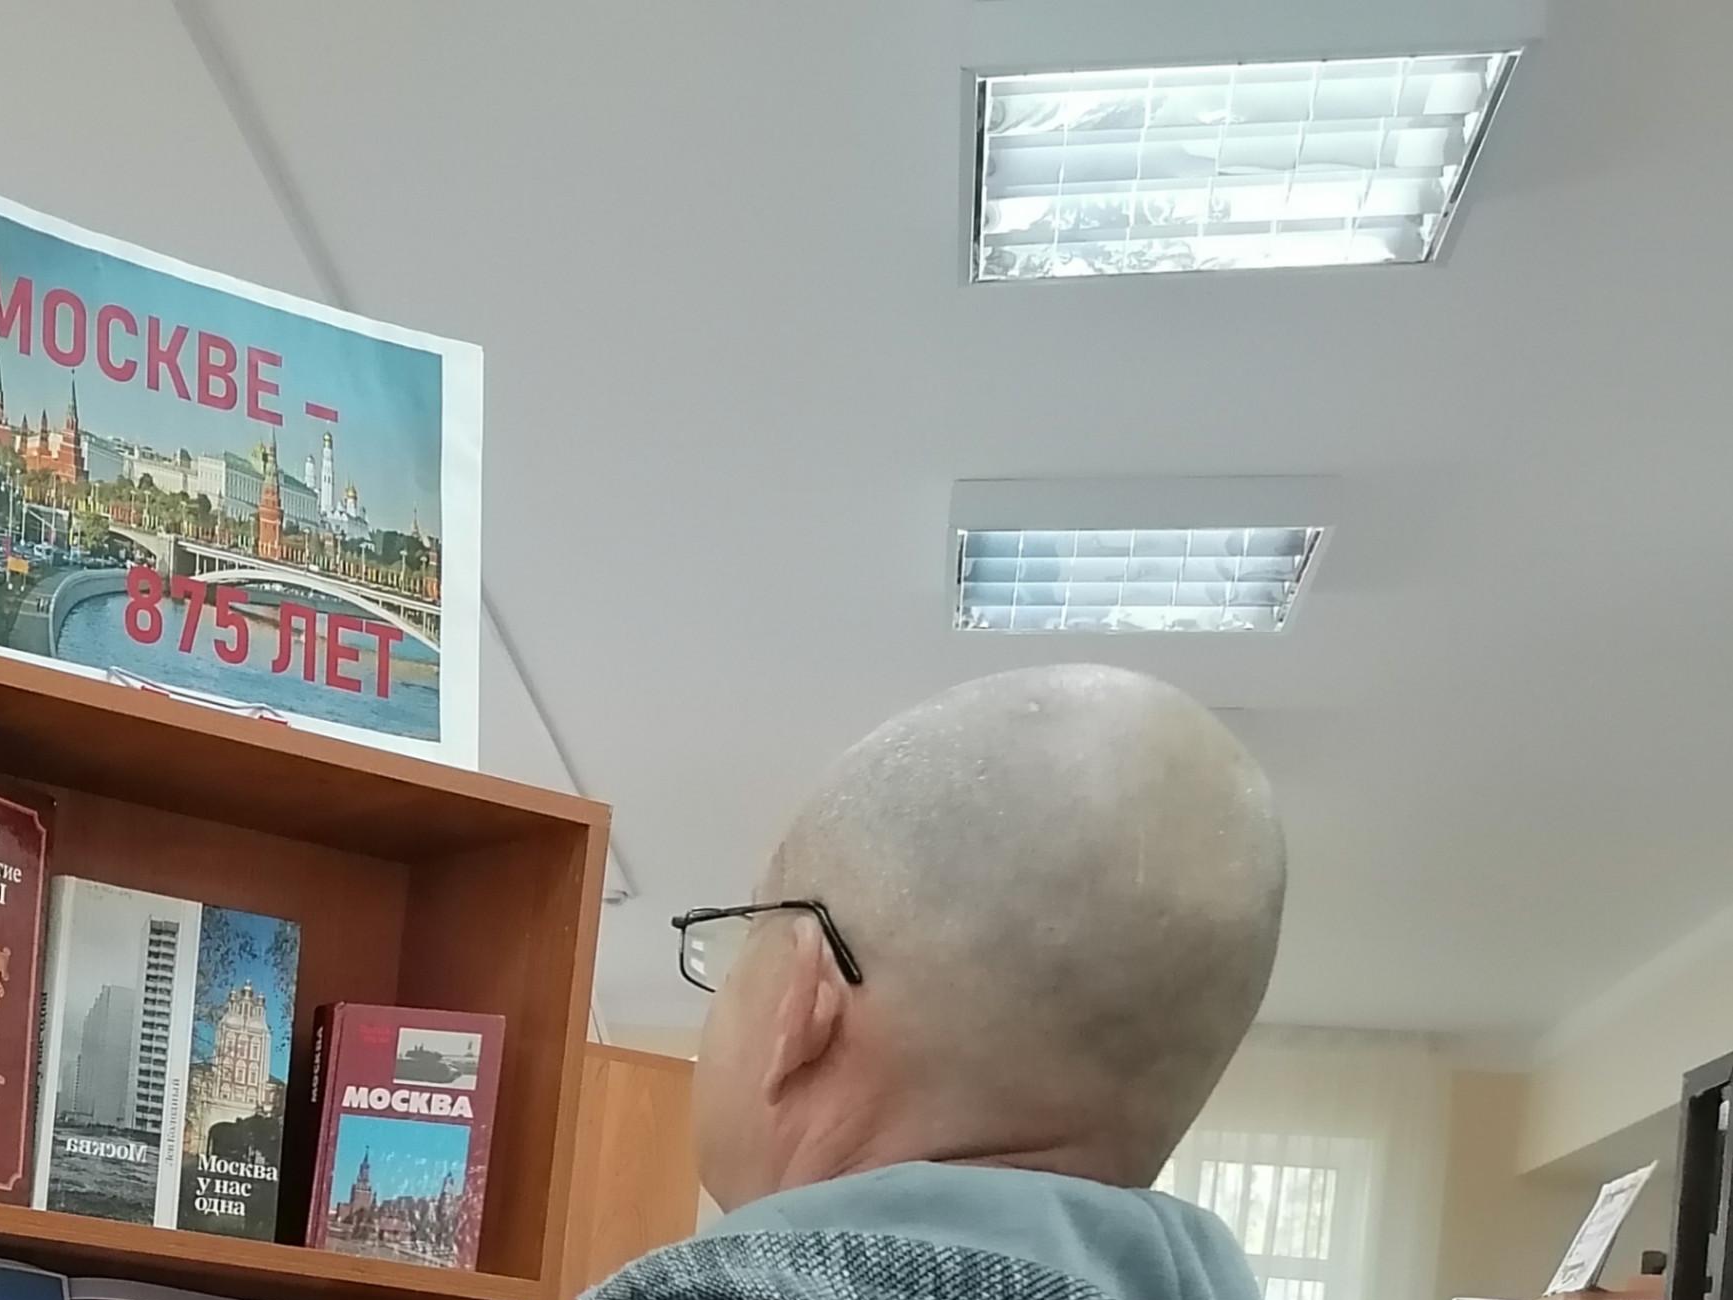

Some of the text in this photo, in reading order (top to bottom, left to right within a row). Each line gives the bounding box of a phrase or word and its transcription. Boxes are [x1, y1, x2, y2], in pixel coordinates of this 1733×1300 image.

[124, 564, 404, 699] 875 ЛЕТ
[310, 1026, 324, 1102] МОСКВА
[342, 1086, 474, 1118] МОСКВА
[197, 1154, 278, 1182] Москва
[197, 1177, 251, 1195] у нас
[194, 1196, 245, 1217] одна
